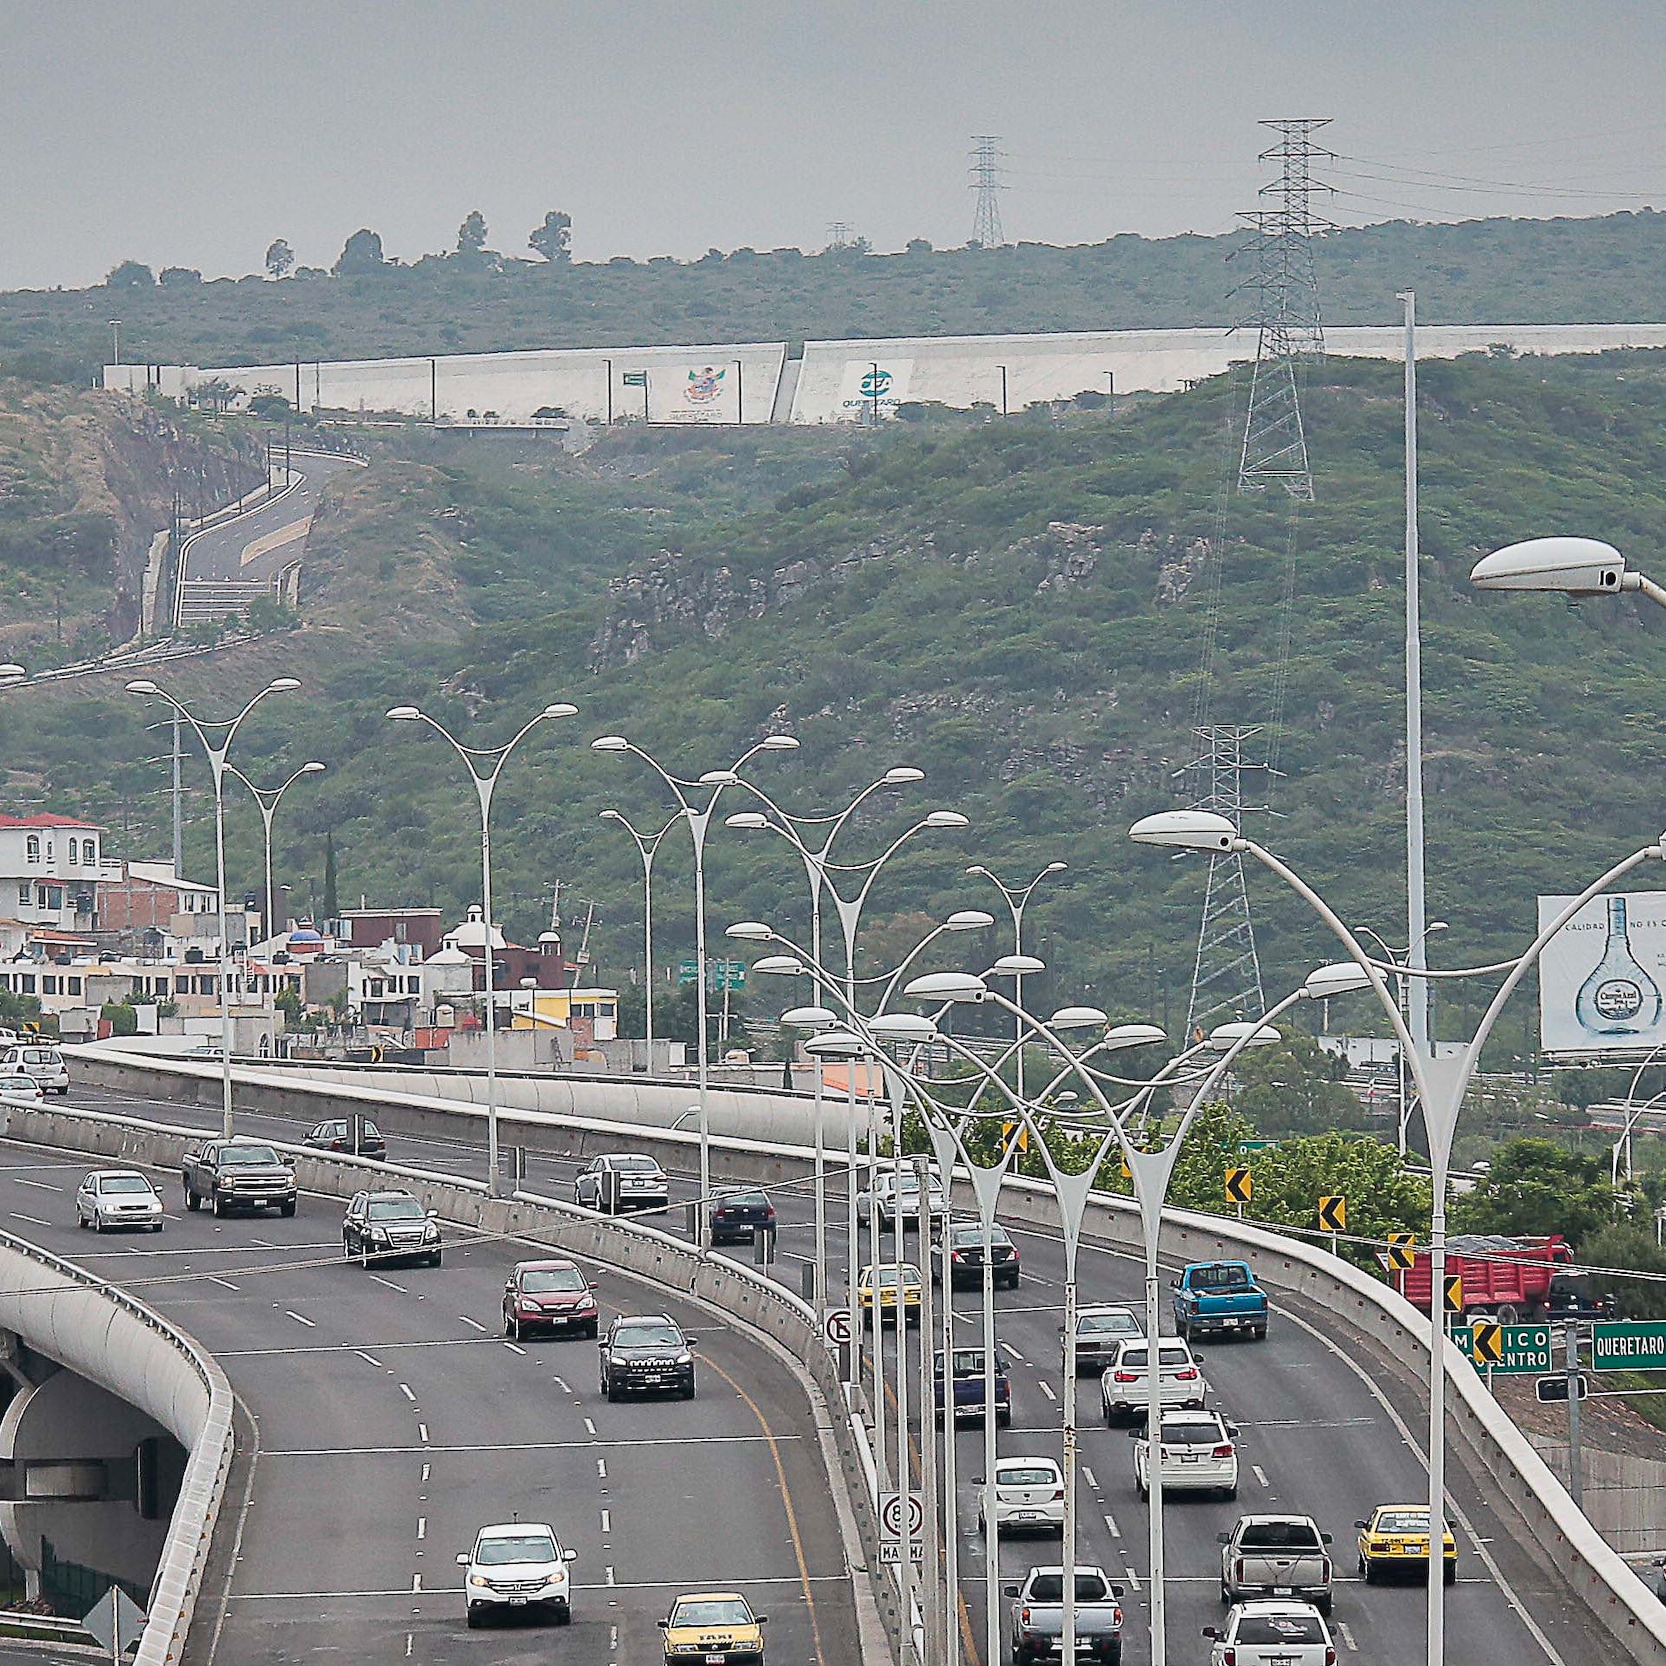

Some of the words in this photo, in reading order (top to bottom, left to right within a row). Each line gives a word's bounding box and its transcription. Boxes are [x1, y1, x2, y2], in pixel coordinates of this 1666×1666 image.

[1565, 923, 1605, 931] CALIDAD
[1454, 1332, 1547, 1349] MICO
[1597, 1335, 1664, 1357] QUERETARO
